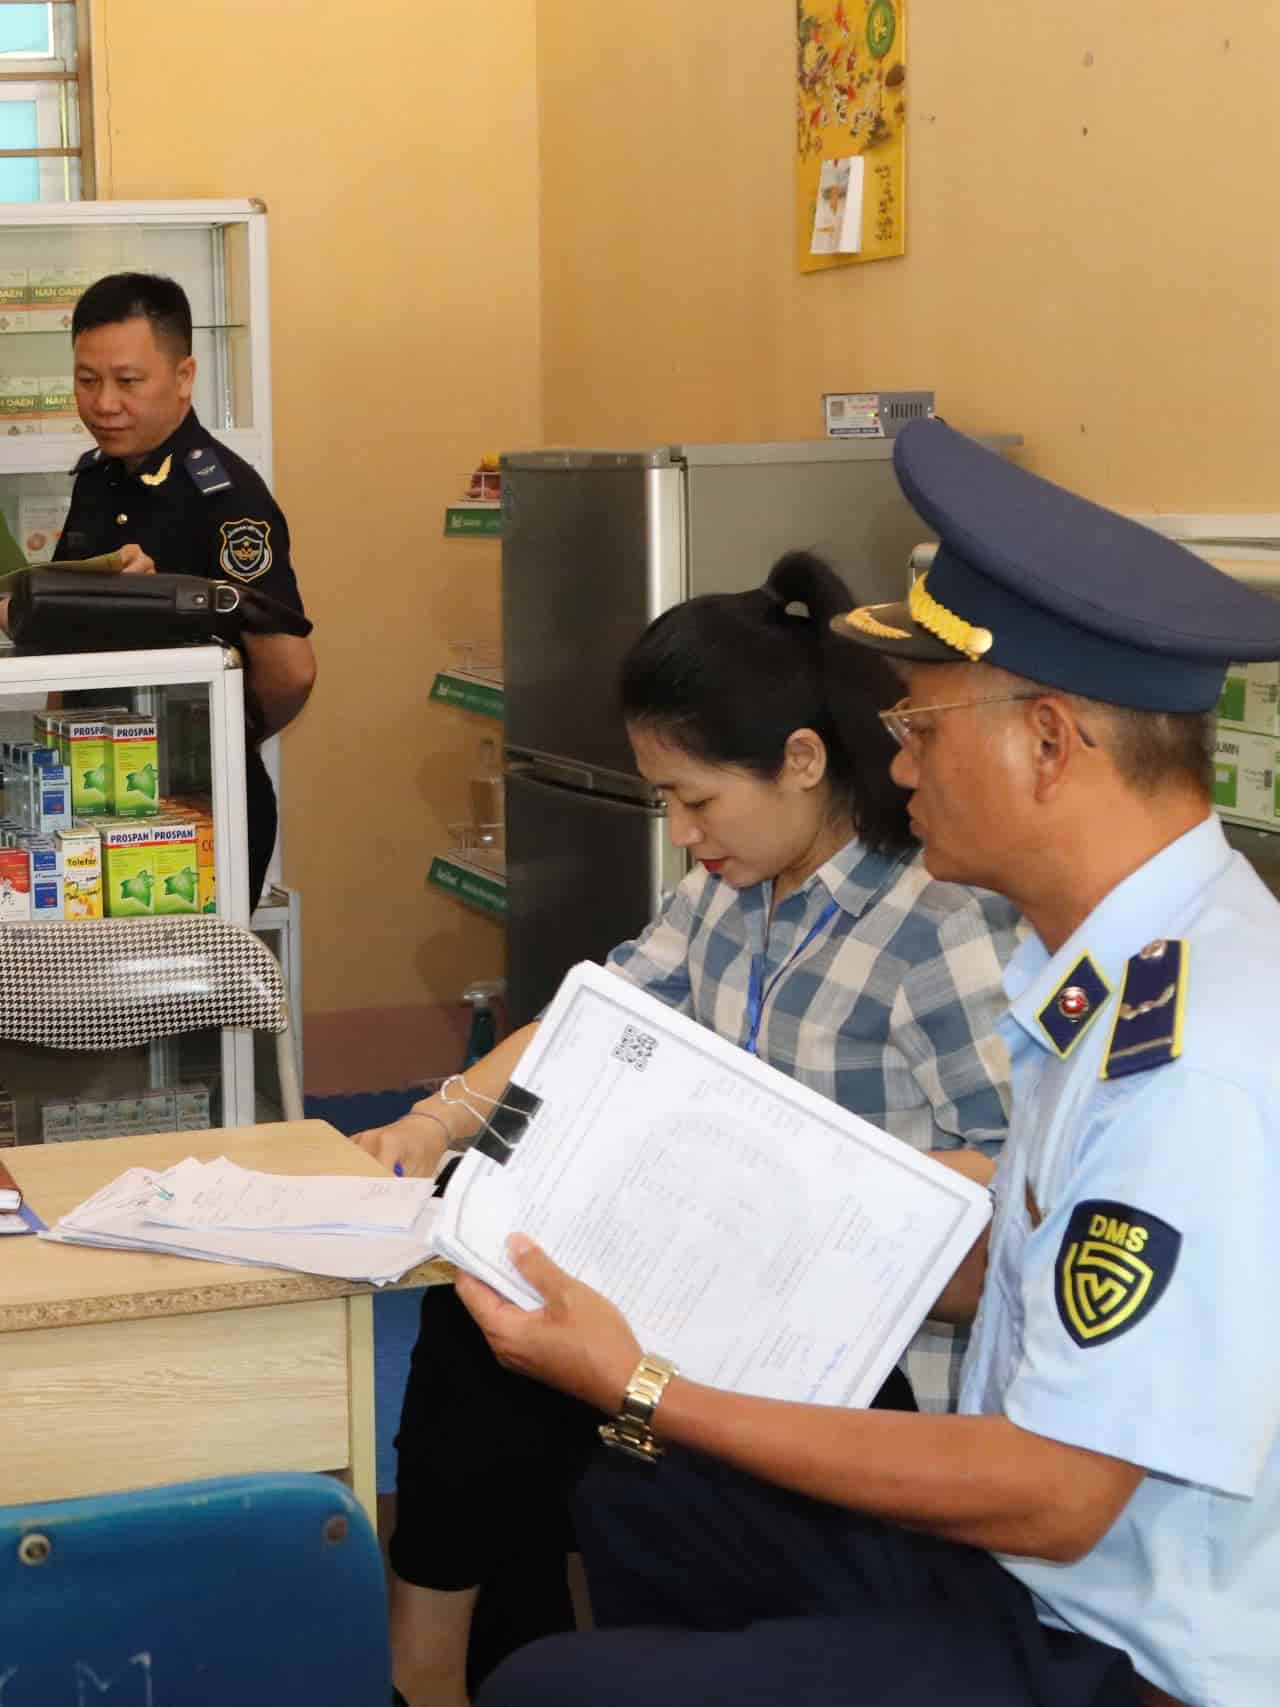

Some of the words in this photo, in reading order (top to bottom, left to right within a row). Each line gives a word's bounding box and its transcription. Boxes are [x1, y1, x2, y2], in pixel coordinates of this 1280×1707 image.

[73, 726, 106, 736] PROSPA
[117, 727, 155, 738] PROSPAN
[110, 832, 149, 843] PROSPAN
[154, 829, 193, 840] PROSPAN
[1087, 1213, 1150, 1254] DMS
